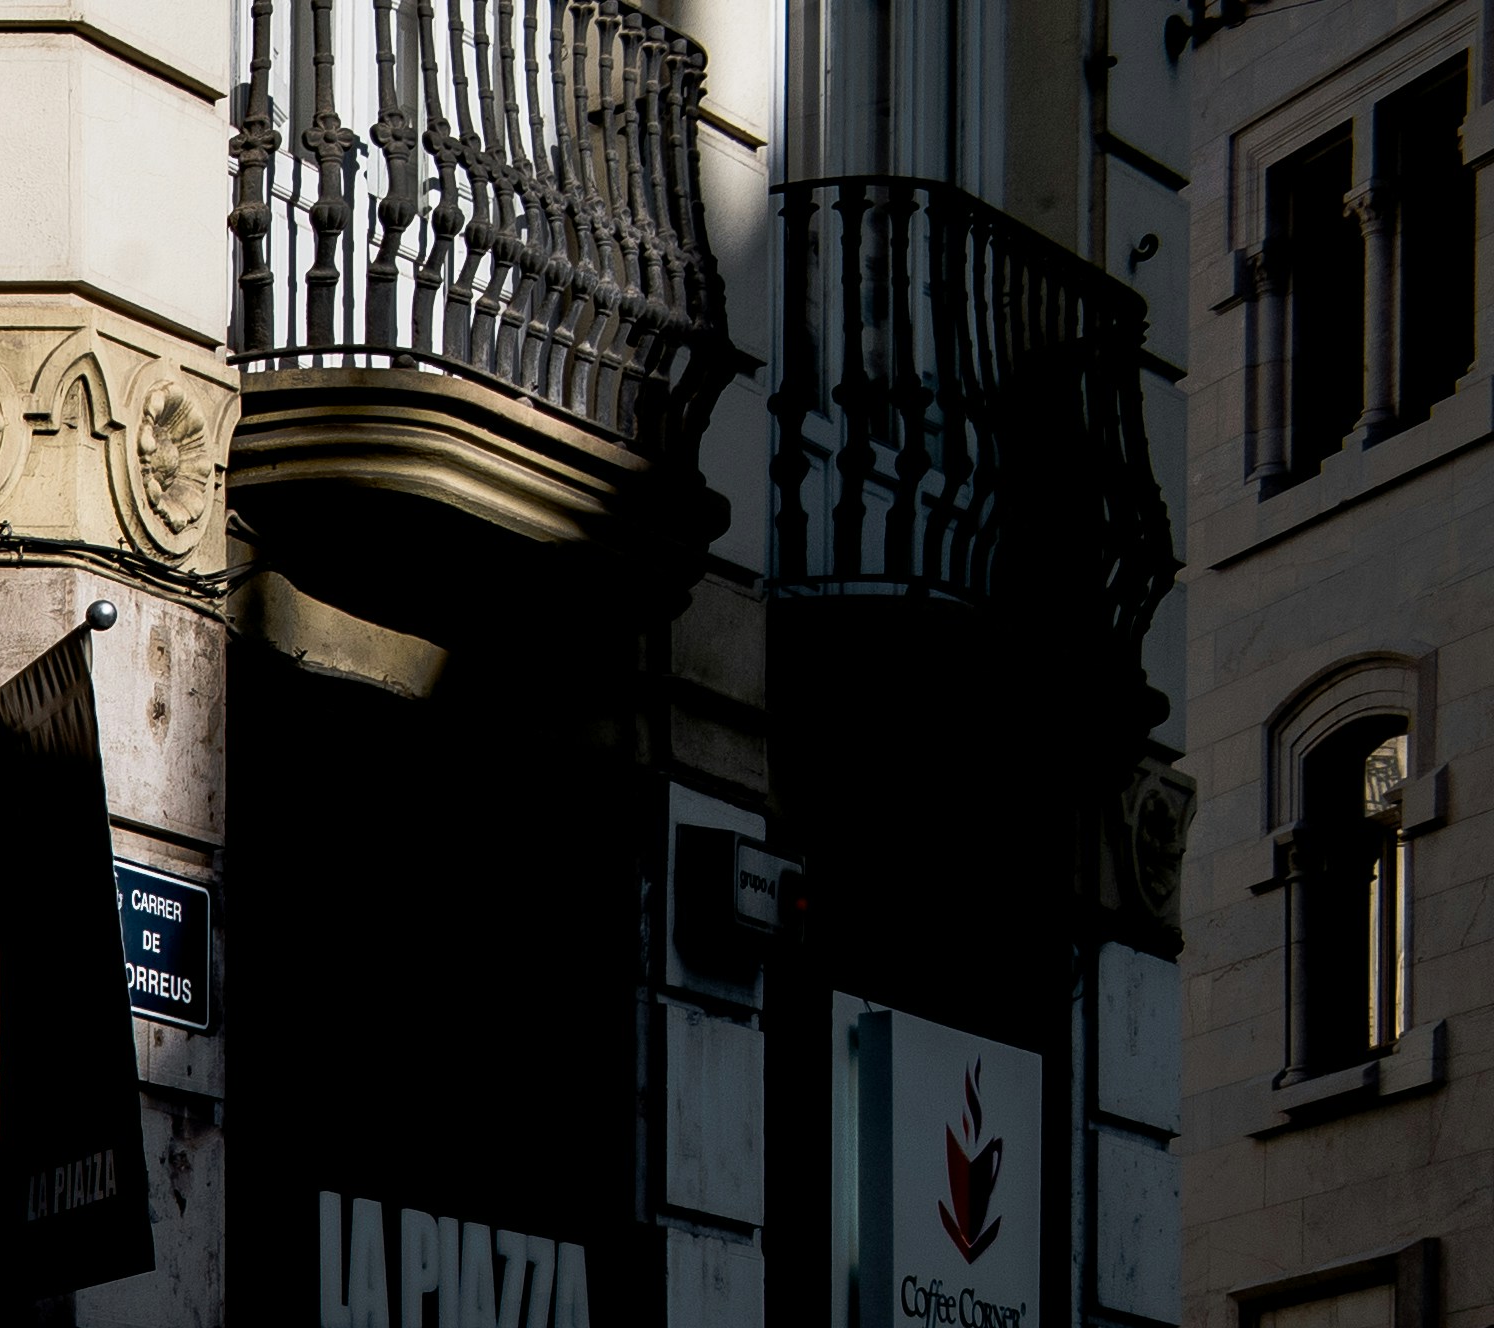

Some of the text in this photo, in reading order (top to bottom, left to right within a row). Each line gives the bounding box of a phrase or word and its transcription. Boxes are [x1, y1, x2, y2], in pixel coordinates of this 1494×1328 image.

[131, 889, 183, 923] CARRER
[142, 929, 161, 954] DE
[125, 962, 192, 1004] ORREUS
[27, 1148, 118, 1222] LA PIAZZA
